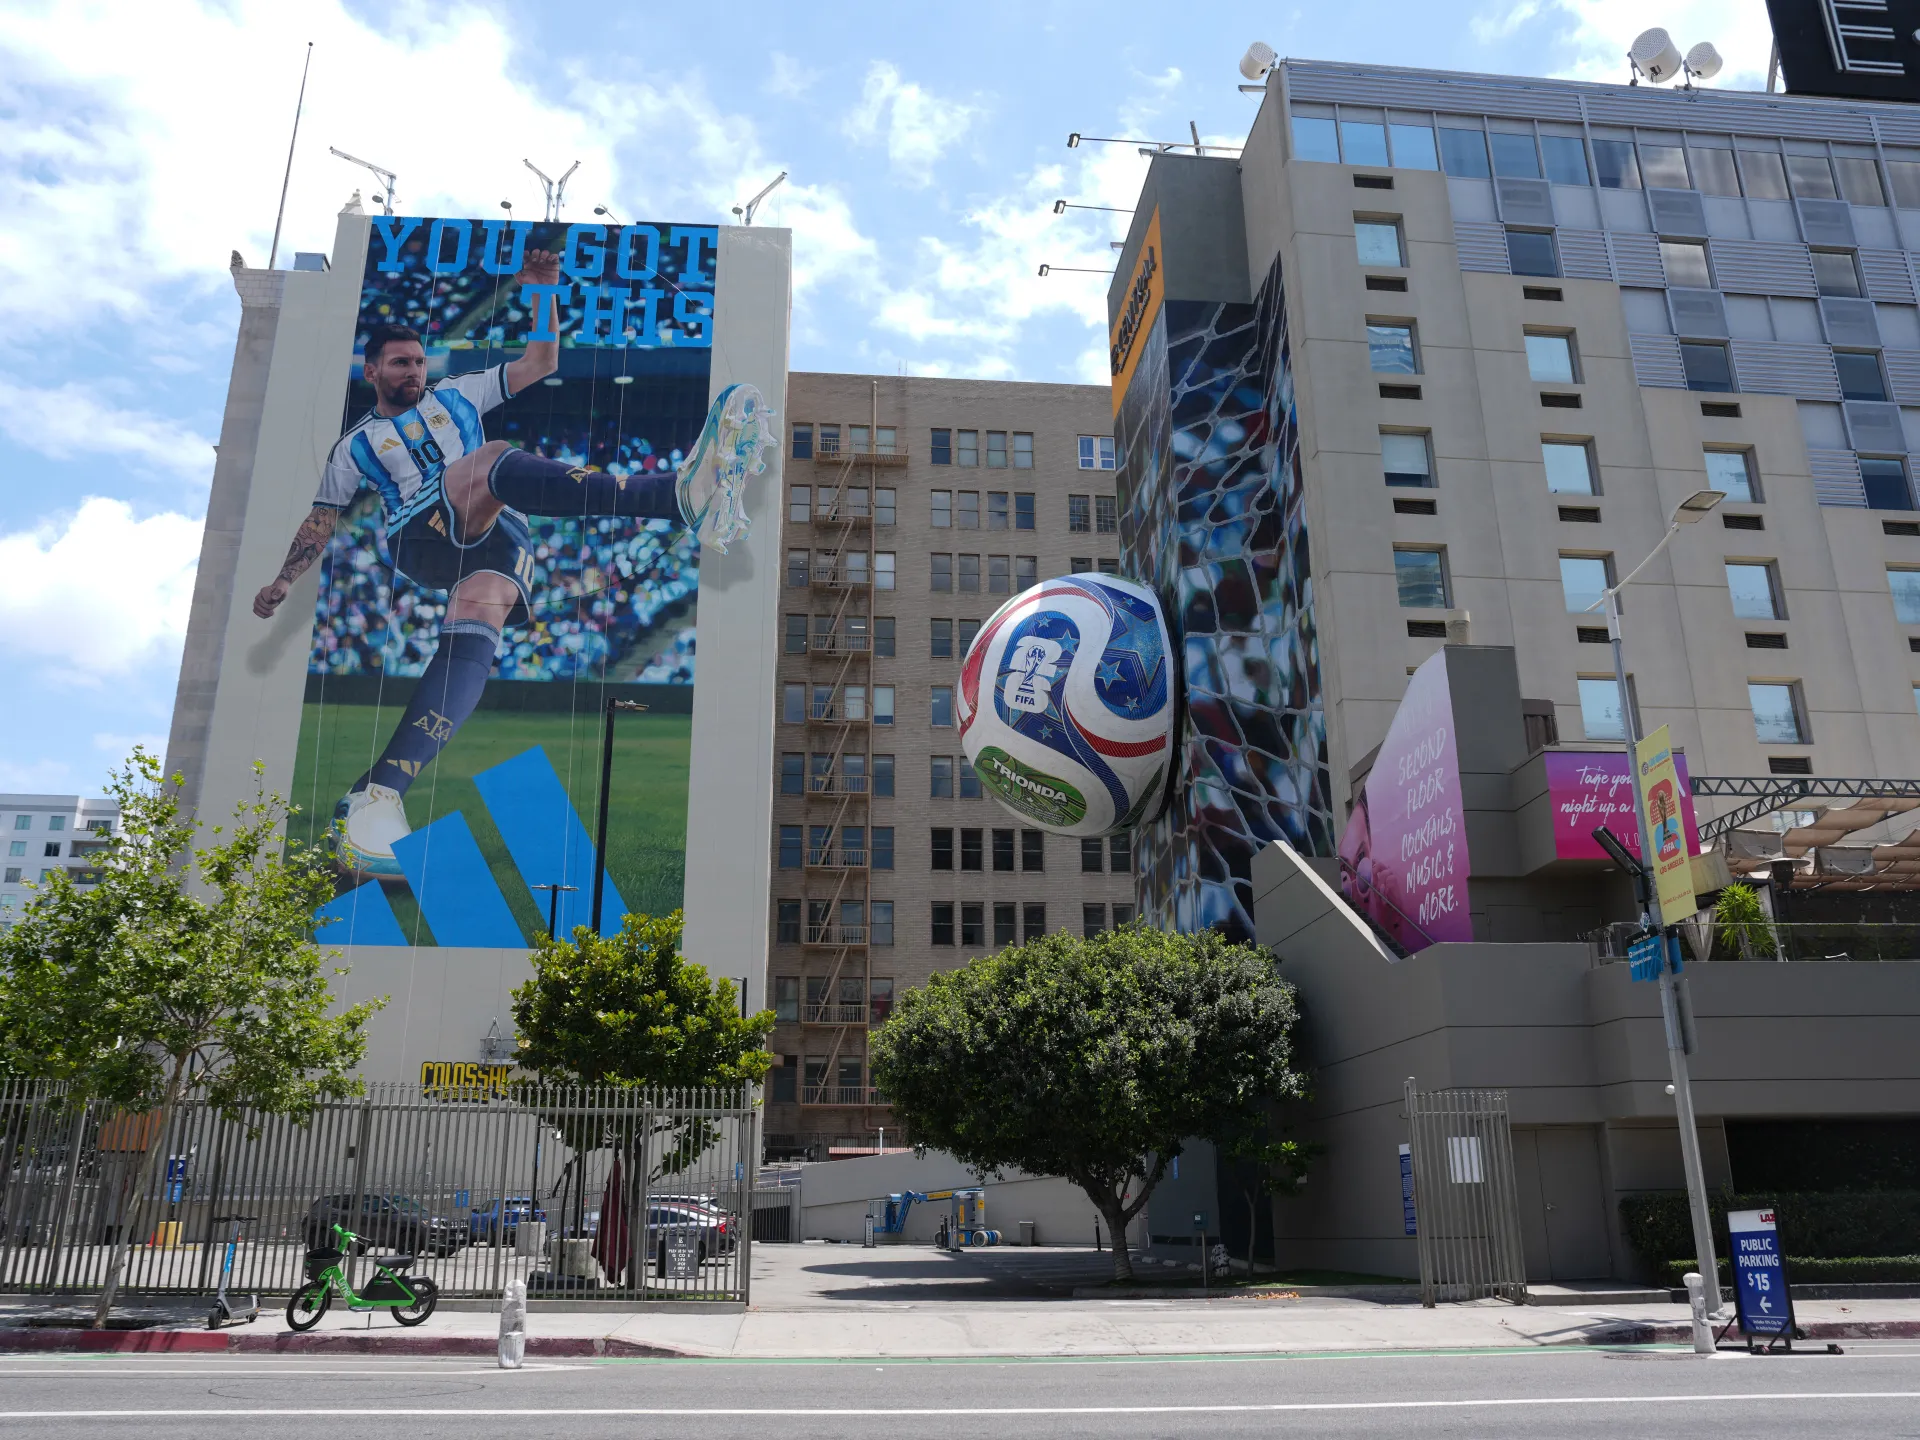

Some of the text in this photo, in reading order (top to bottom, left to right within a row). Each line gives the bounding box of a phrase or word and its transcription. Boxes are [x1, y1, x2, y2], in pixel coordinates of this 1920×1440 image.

[372, 215, 718, 283] YOU GOT
[520, 284, 715, 347] THIS
[409, 438, 446, 471] 10
[514, 546, 534, 593] 10
[1015, 693, 1036, 707] FIFA
[1398, 727, 1447, 786] SECOND
[992, 757, 1068, 802] TRIONDA
[1407, 767, 1445, 820] FLOOR
[1560, 793, 1631, 827] night up a
[1663, 842, 1676, 854] FIFA
[1659, 856, 1685, 876] LOS ANGELES
[1419, 884, 1459, 926] MORE.
[1760, 1213, 1776, 1223] LAZ
[1739, 1254, 1780, 1267] PARKING
[1740, 1238, 1773, 1251] PUBLIC
[337, 1276, 351, 1297] Lime
